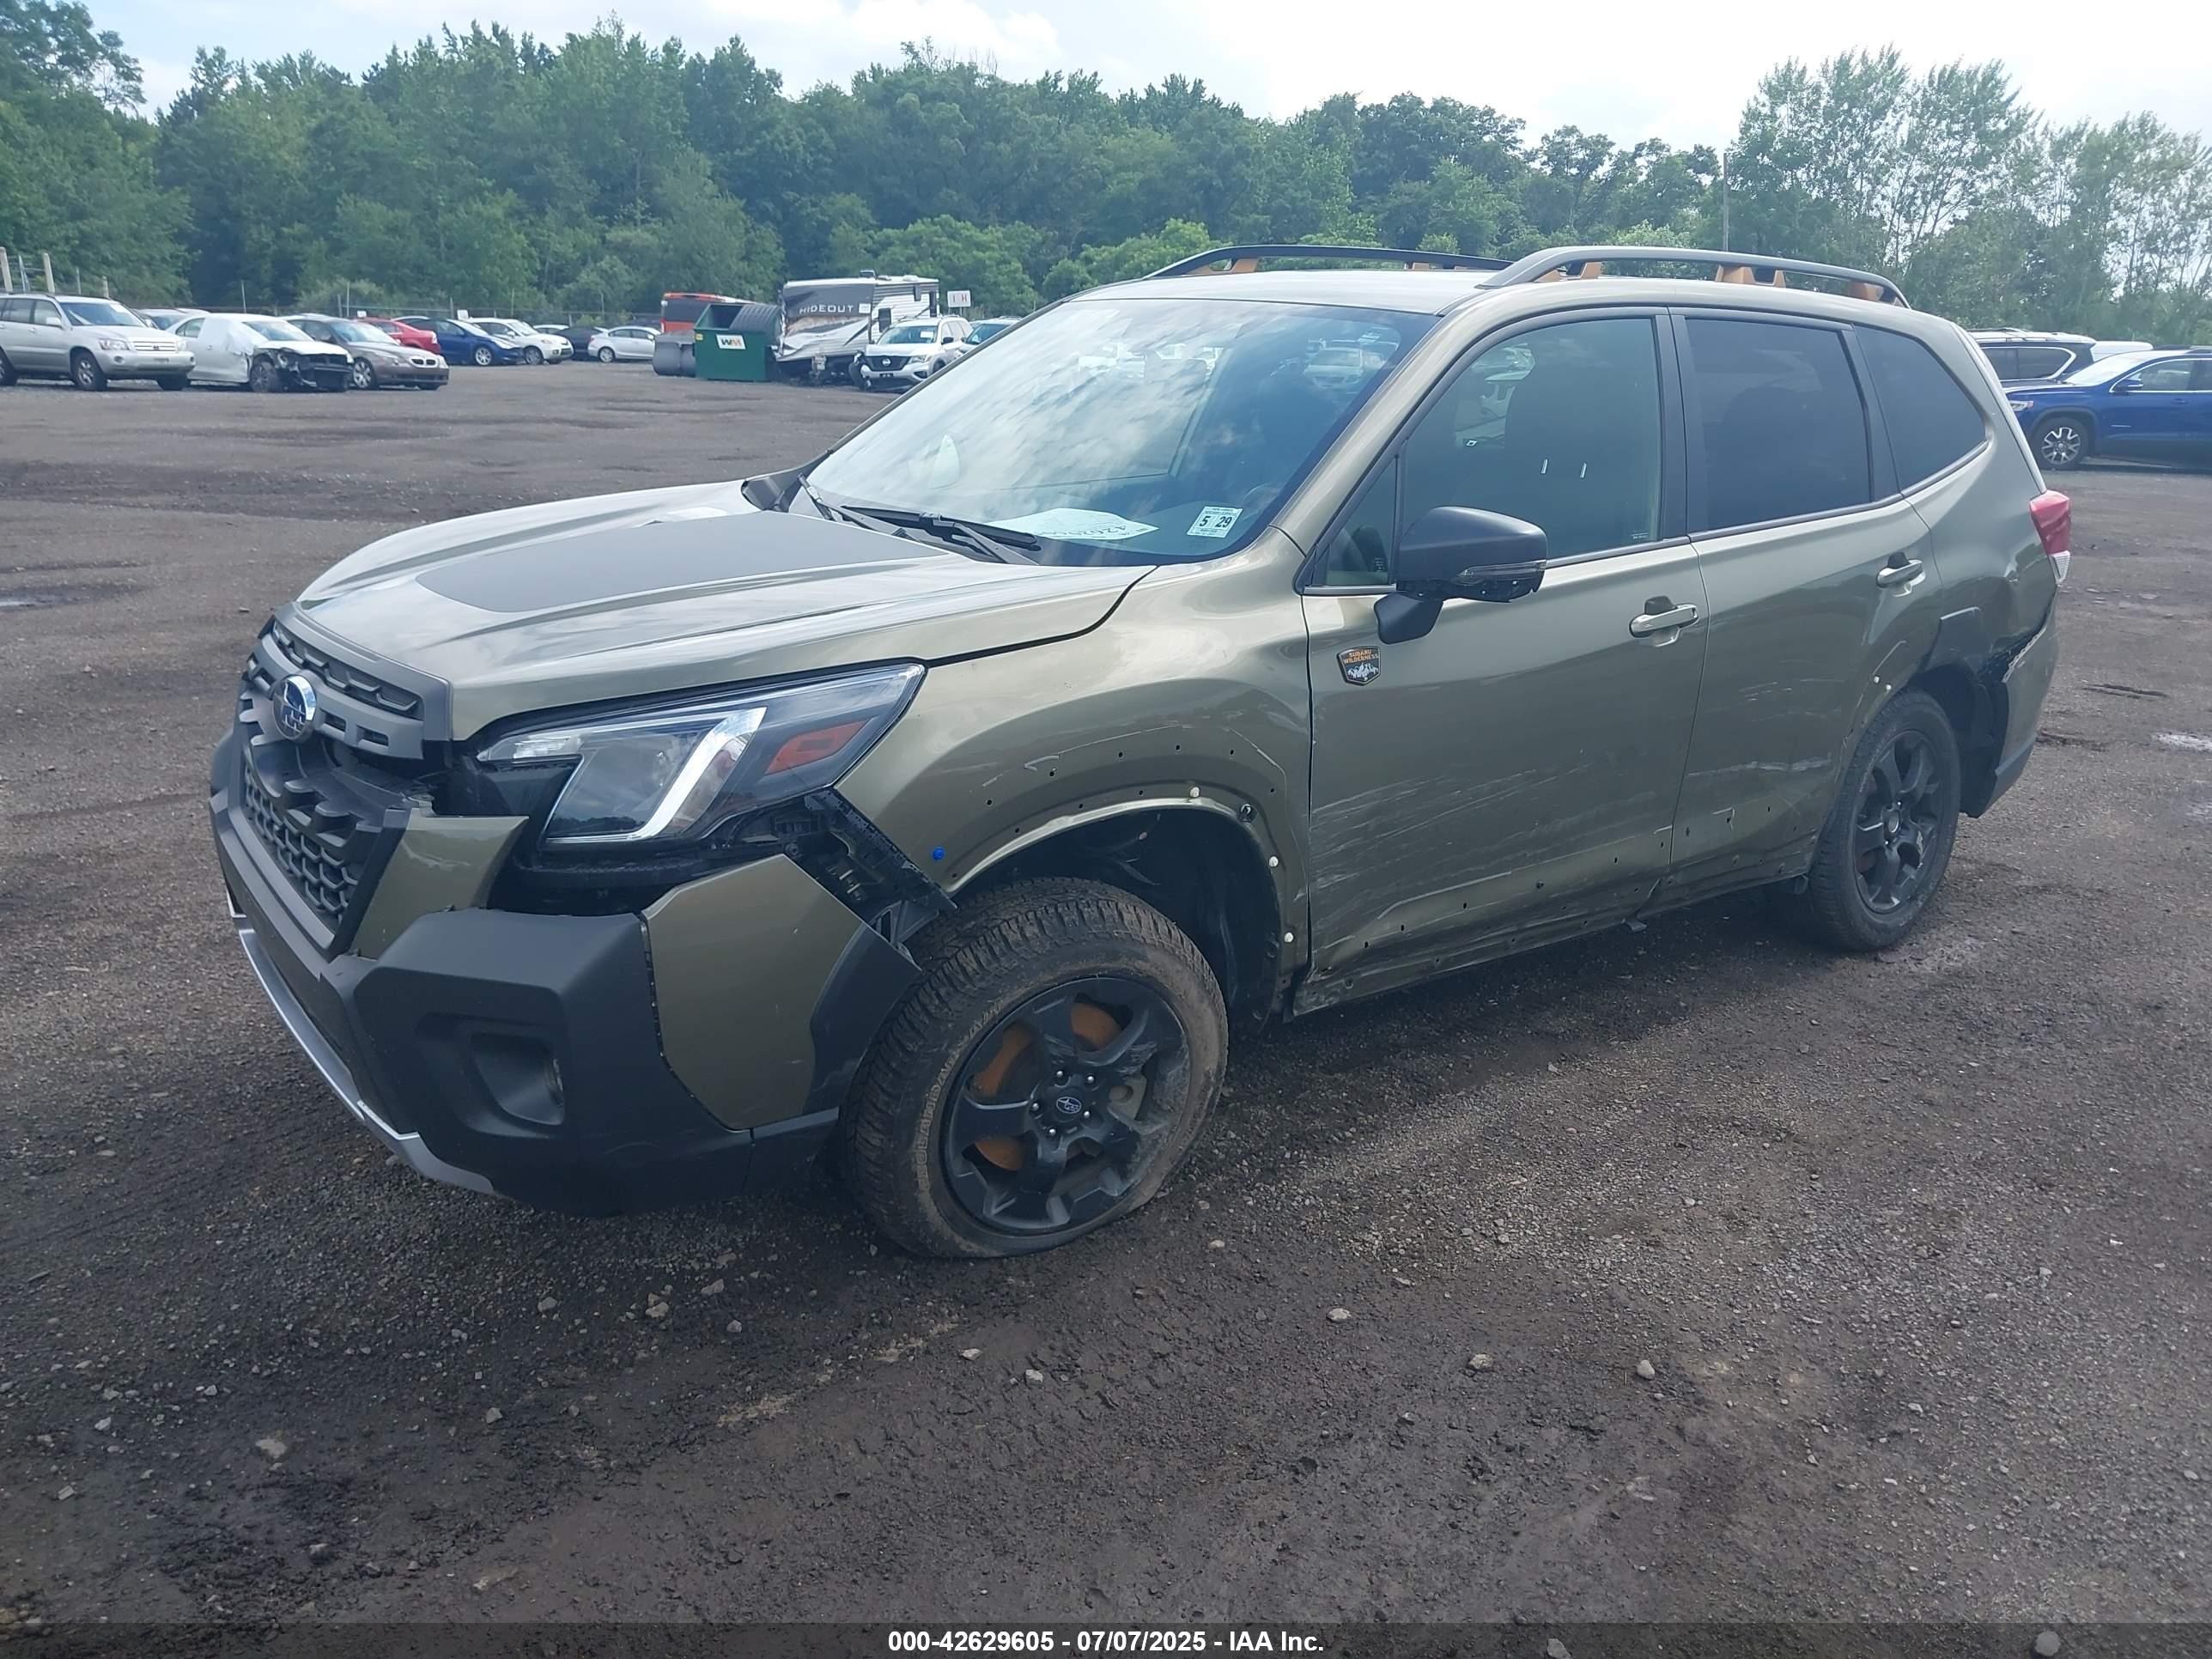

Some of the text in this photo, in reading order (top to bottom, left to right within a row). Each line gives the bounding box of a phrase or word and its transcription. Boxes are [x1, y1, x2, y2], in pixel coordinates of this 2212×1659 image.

[799, 304, 854, 315] HIDEOUT
[1199, 515, 1233, 528] 5 29
[1343, 653, 1379, 664] WILDERNESS
[1348, 649, 1372, 658] SUBARU
